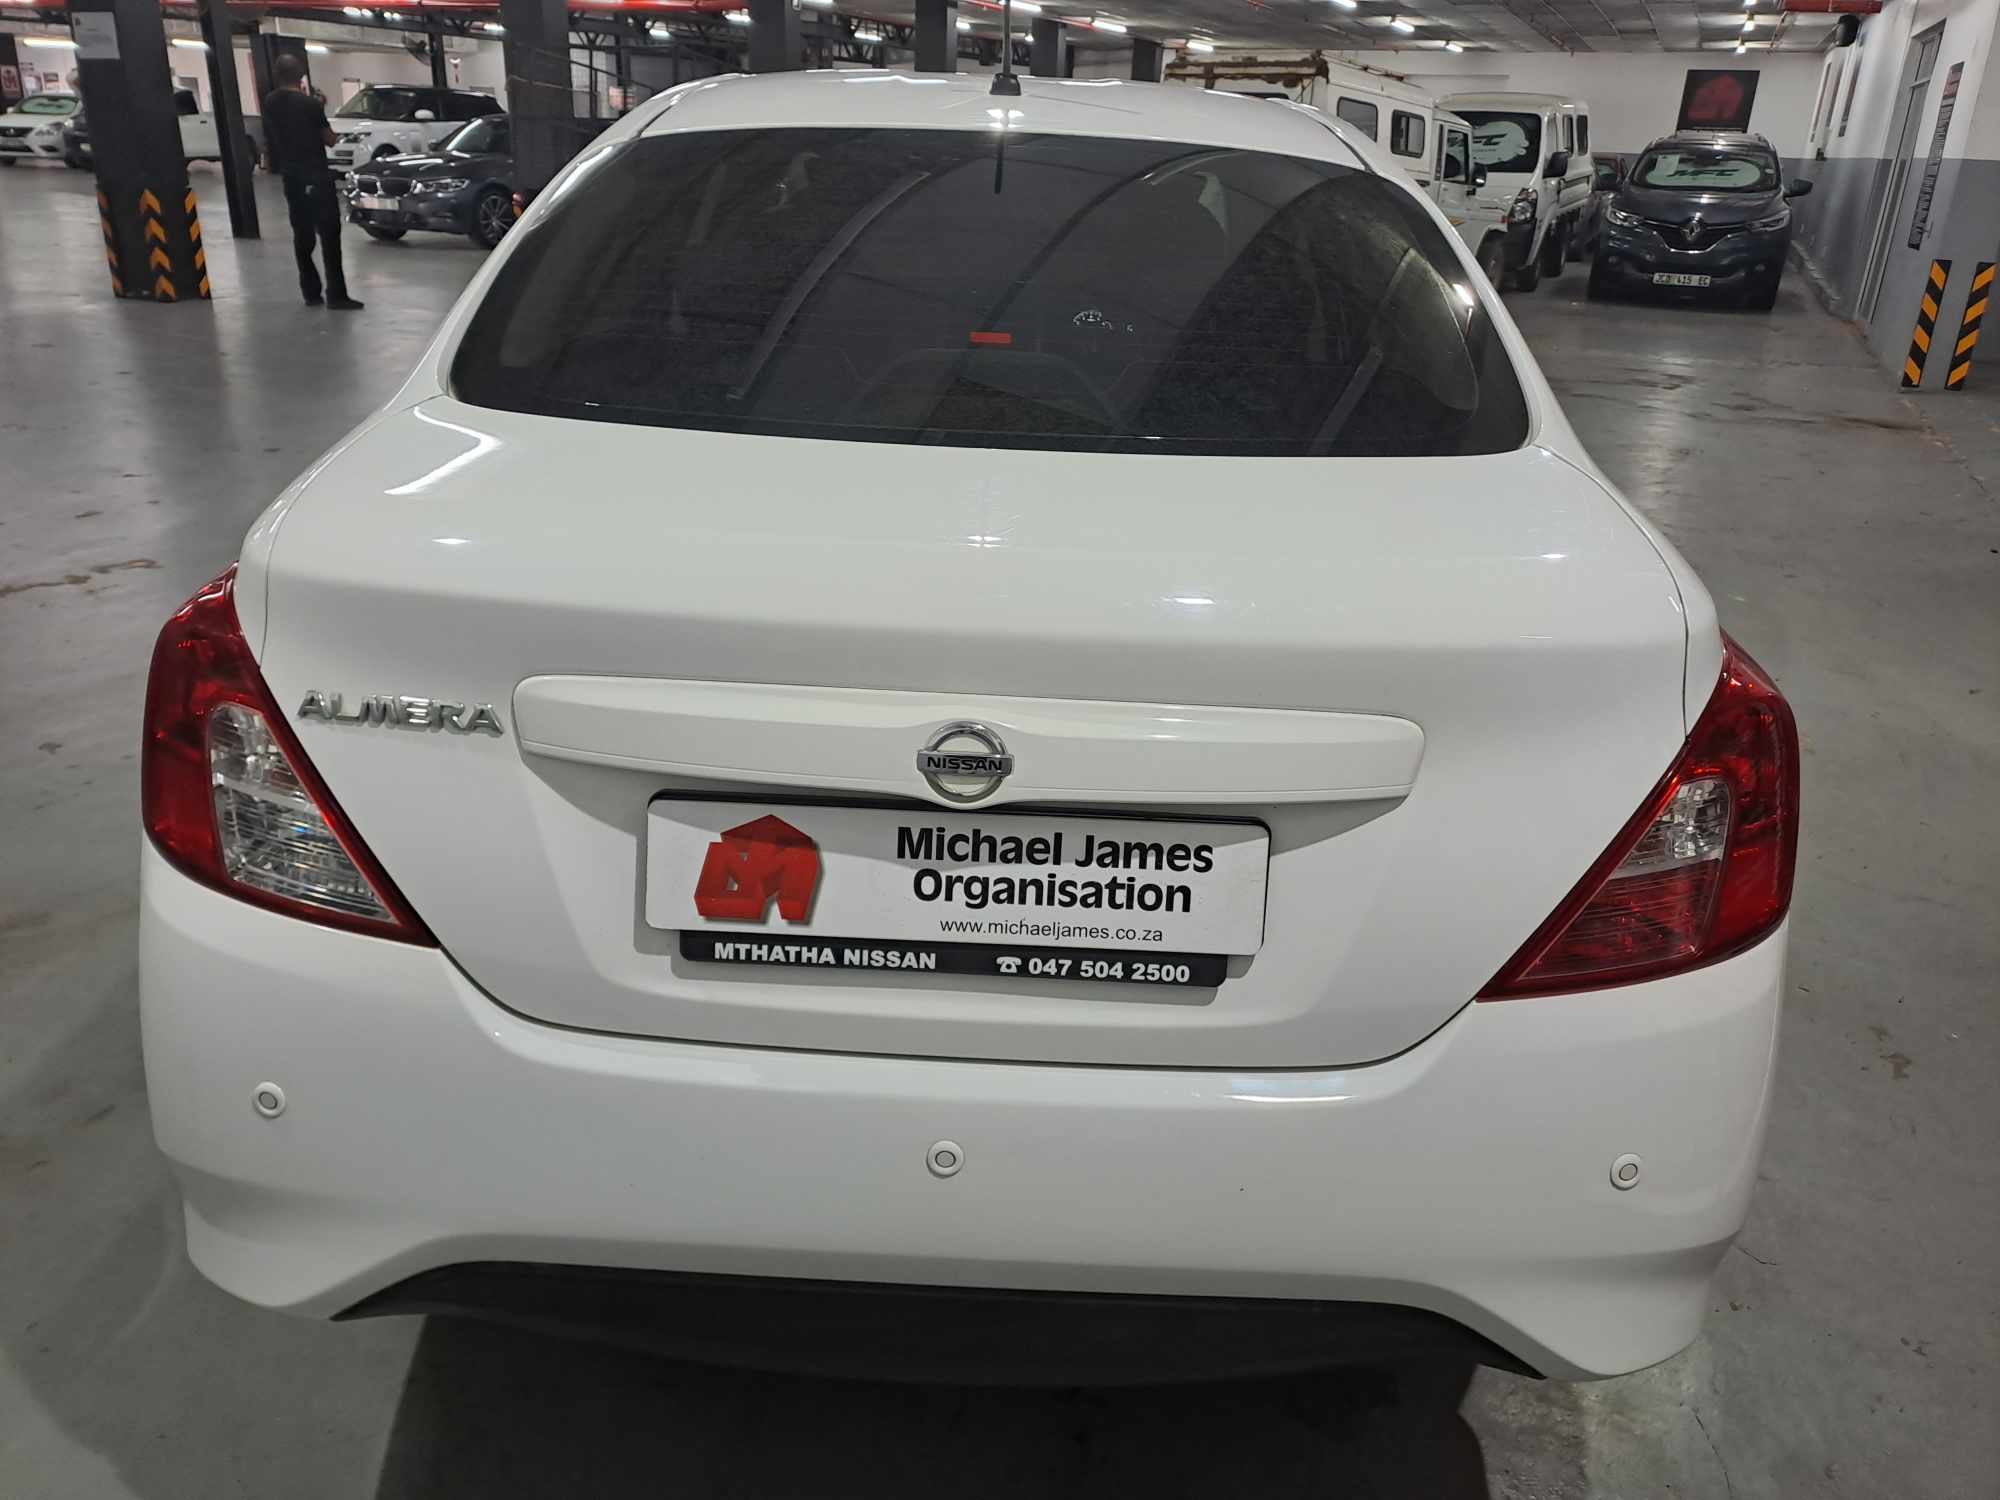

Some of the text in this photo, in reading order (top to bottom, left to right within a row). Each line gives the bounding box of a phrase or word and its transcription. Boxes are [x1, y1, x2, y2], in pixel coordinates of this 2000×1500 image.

[297, 690, 504, 736] ALMERA
[927, 756, 1002, 771] NISSAN
[896, 826, 1214, 873] Michael James
[913, 868, 1192, 913] Organisation
[939, 919, 1163, 942] www.michaeljames.co.za
[714, 942, 936, 969] MTHATHA NISSAN
[1028, 957, 1190, 982] 047 504 2500
